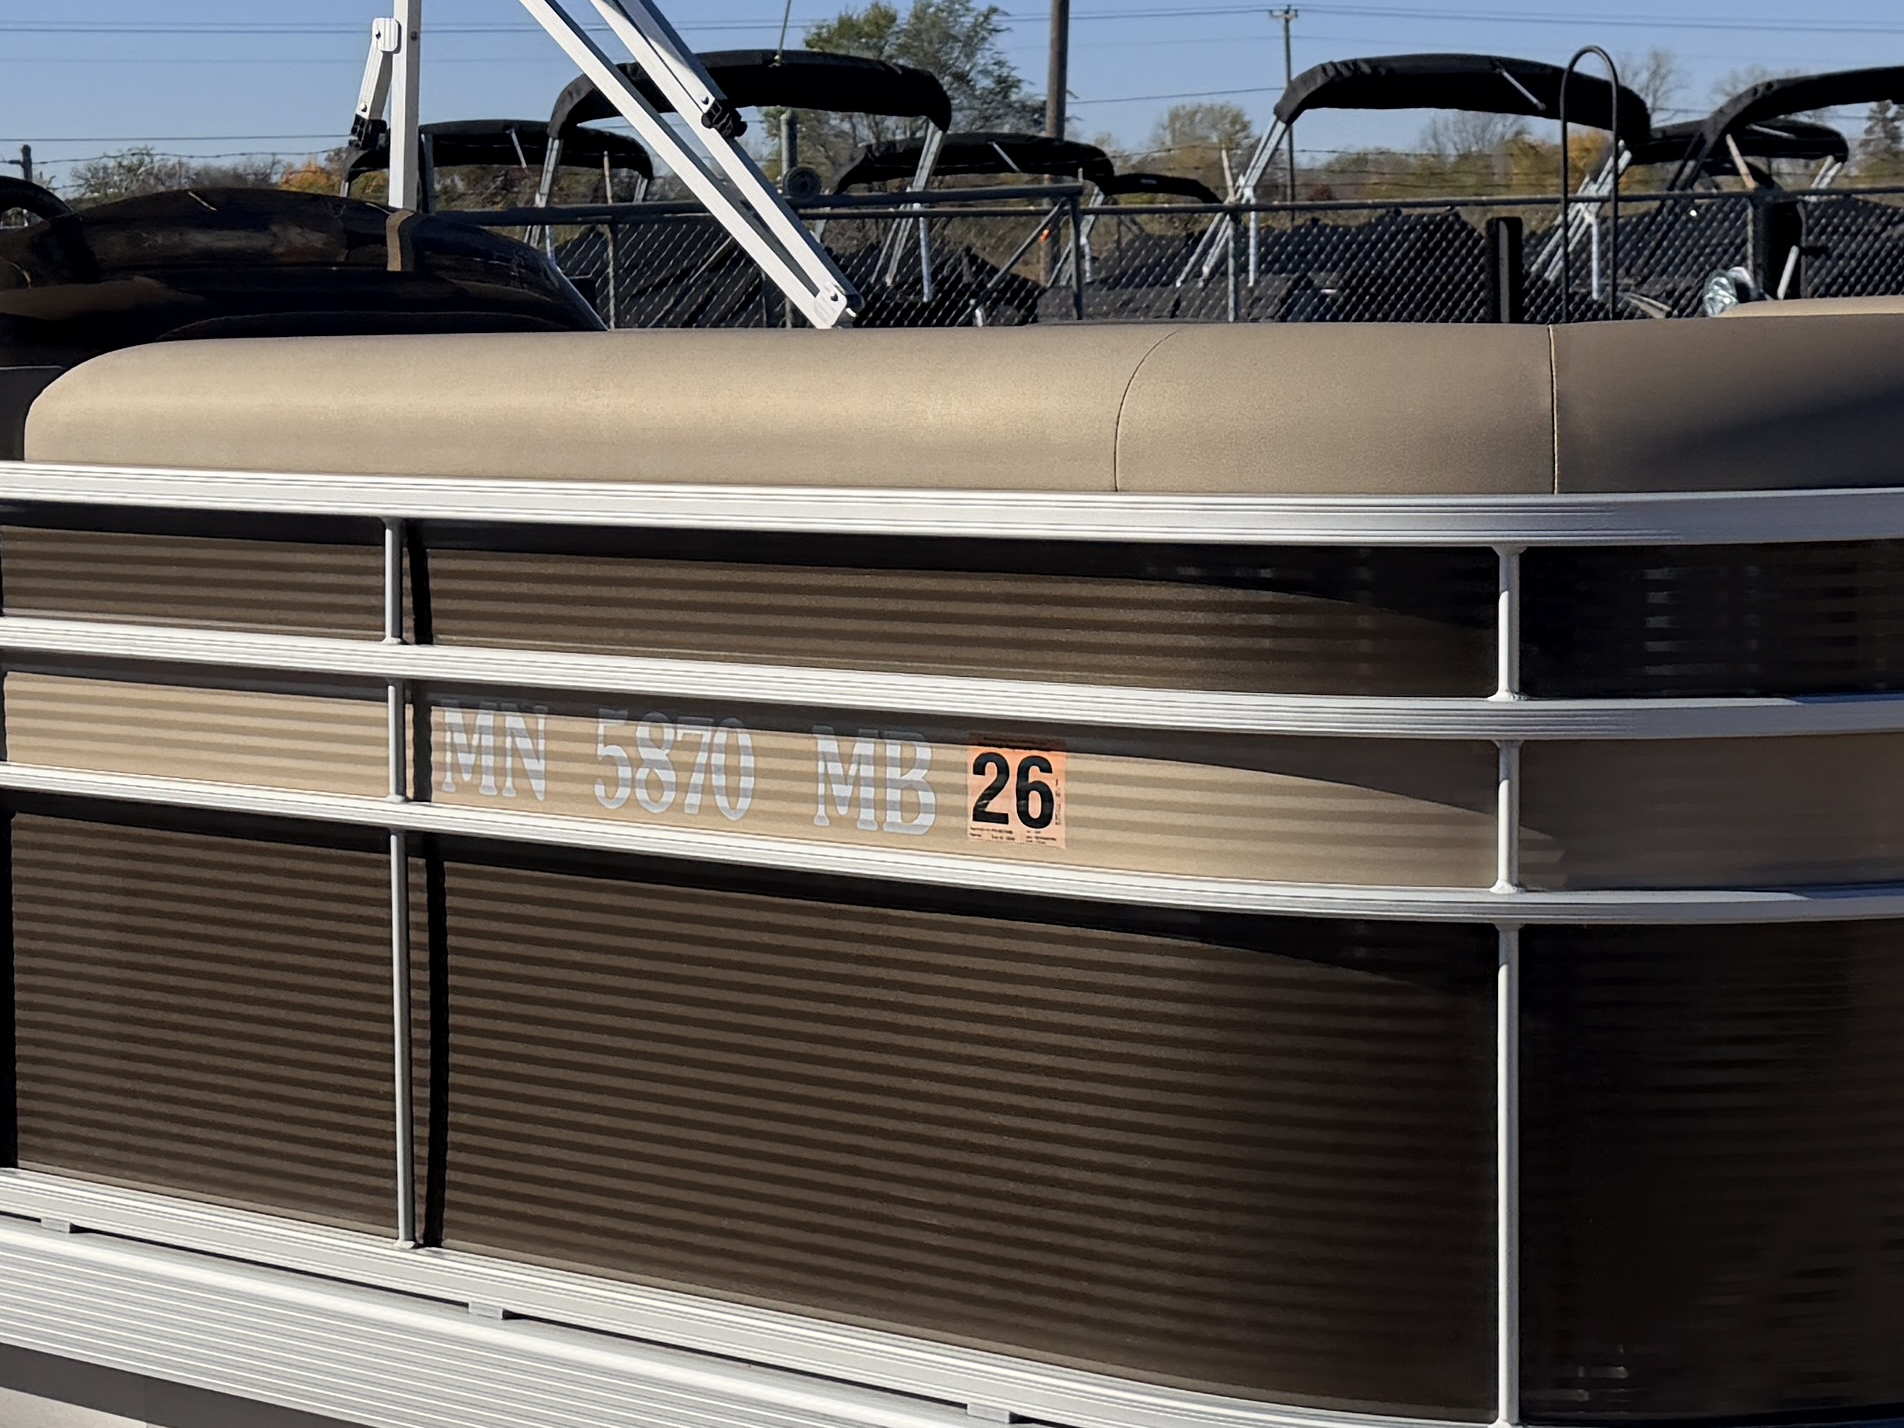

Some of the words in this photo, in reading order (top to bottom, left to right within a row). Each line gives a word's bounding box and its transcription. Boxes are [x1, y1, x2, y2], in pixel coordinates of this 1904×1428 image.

[440, 699, 548, 802] MN
[595, 708, 755, 821] 5870
[811, 725, 936, 835] MB
[972, 752, 1054, 829] 26
